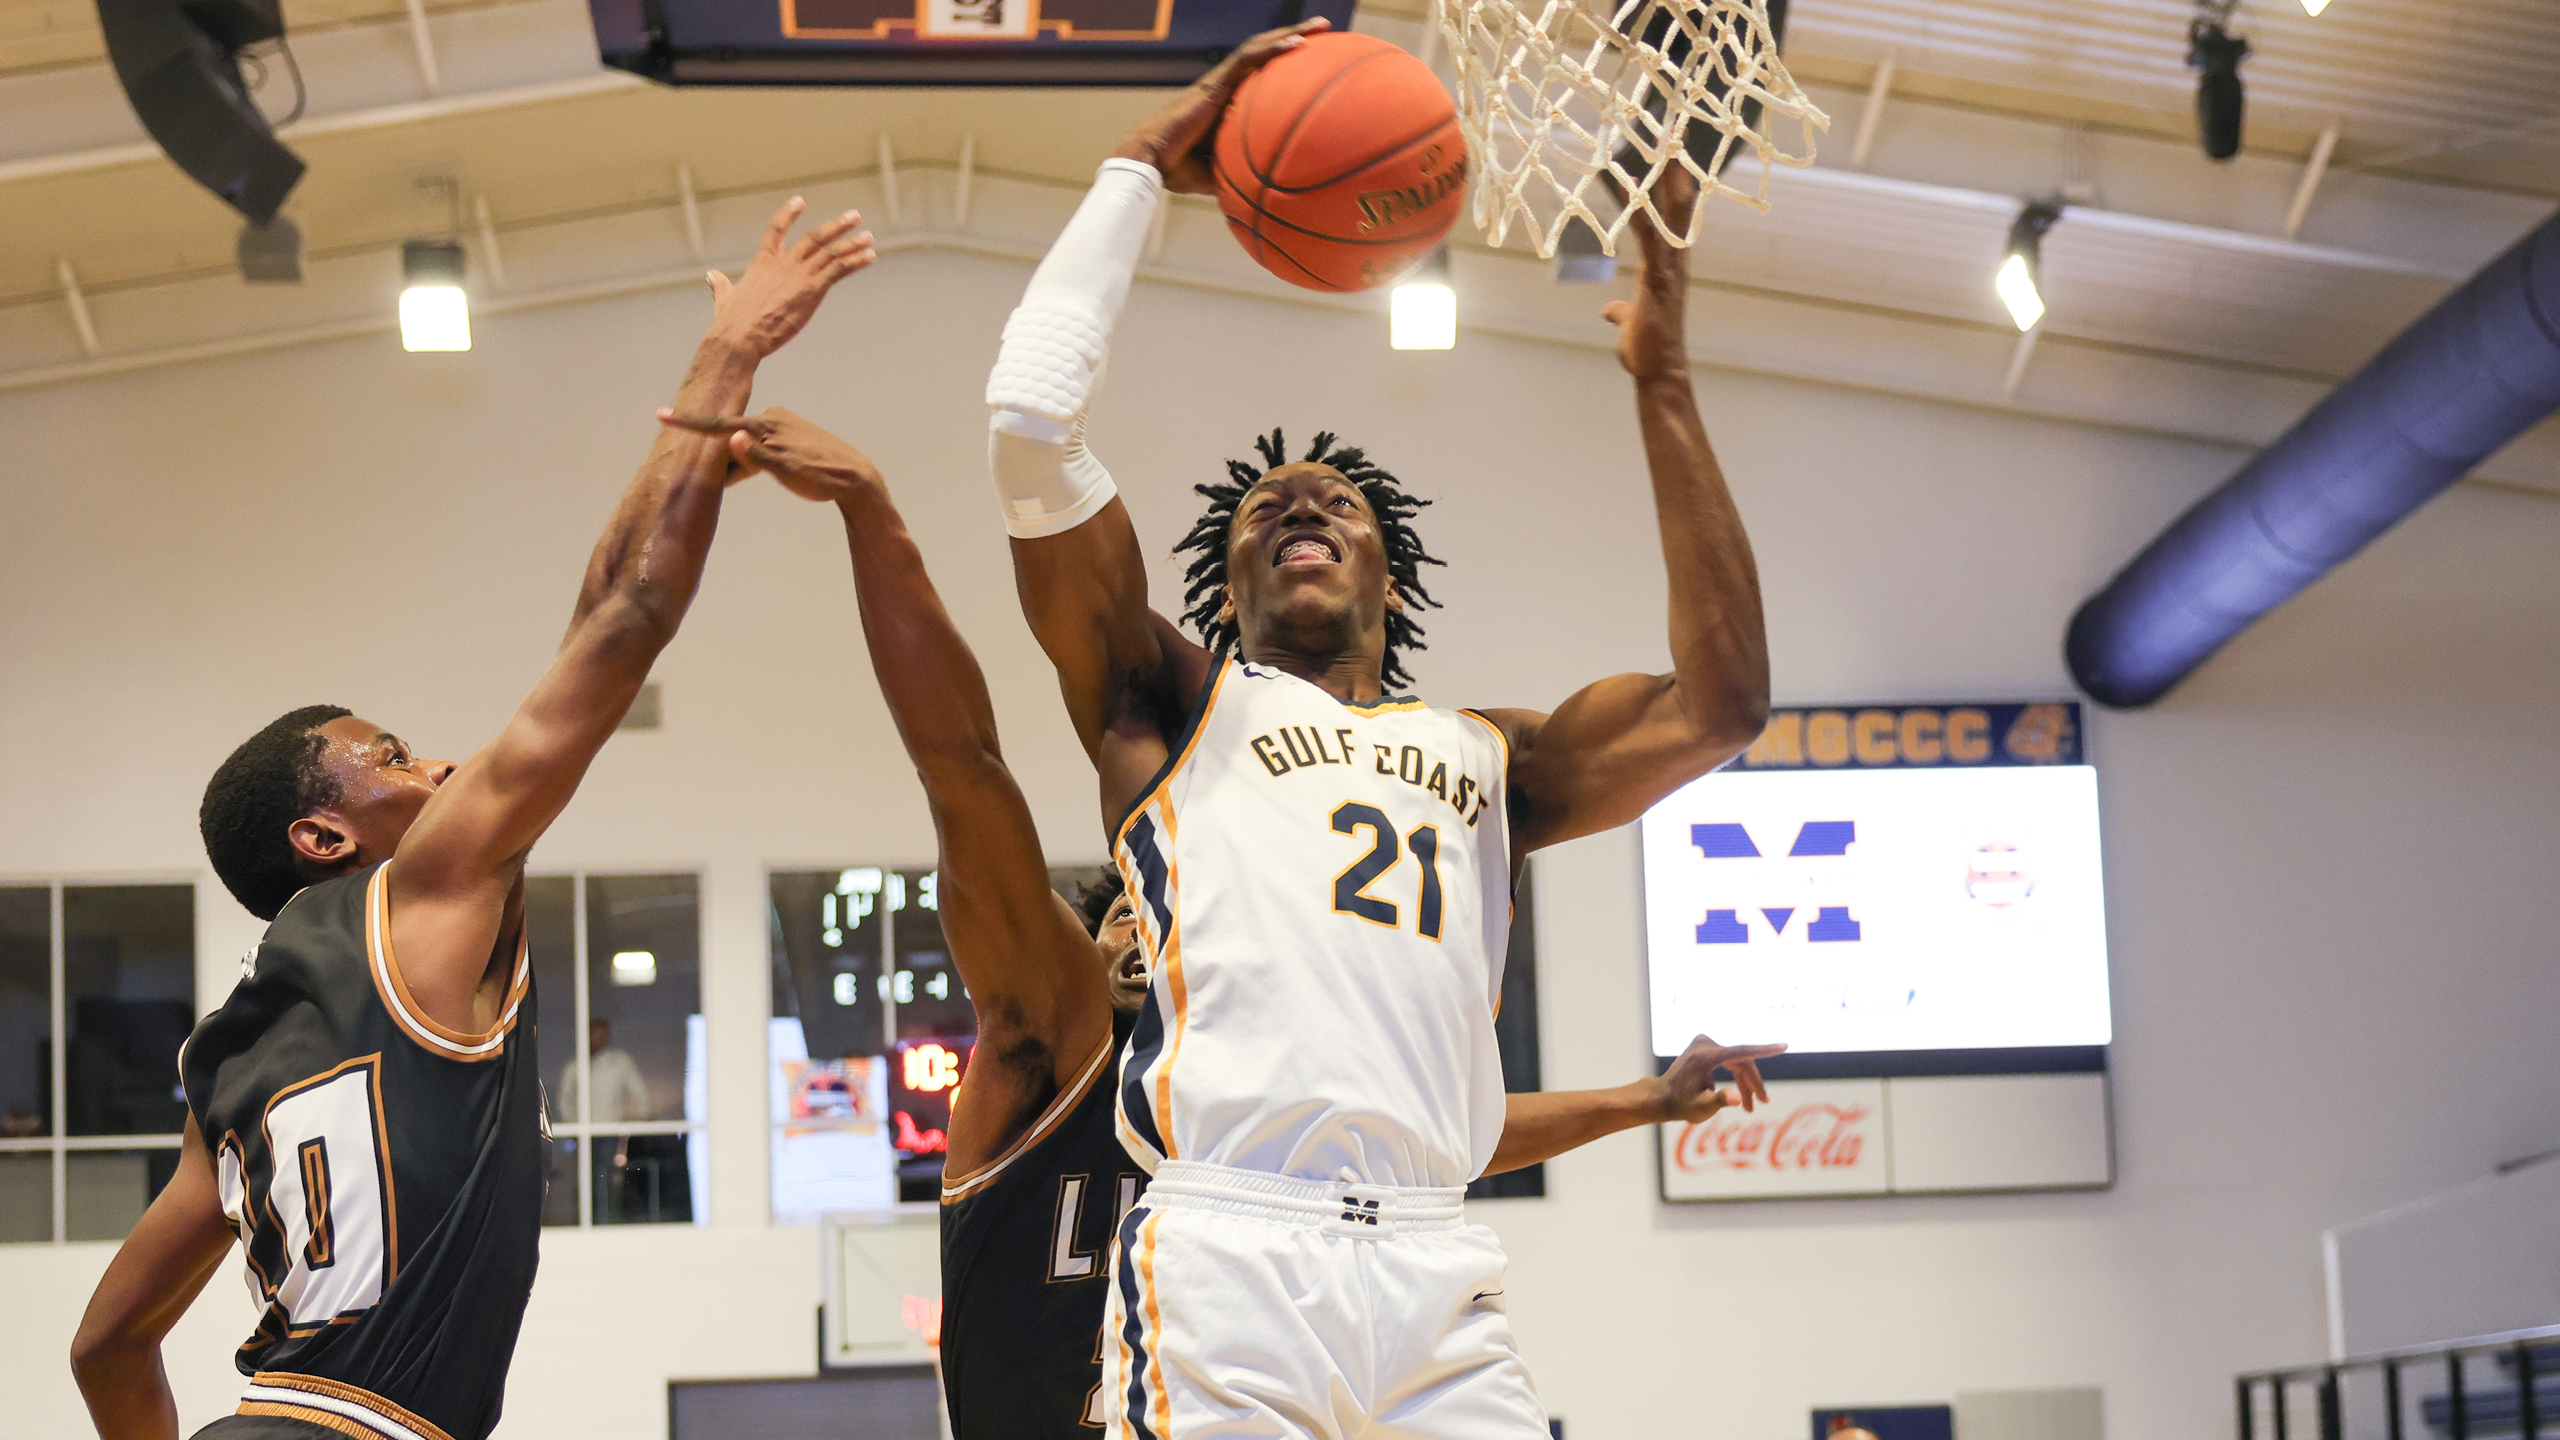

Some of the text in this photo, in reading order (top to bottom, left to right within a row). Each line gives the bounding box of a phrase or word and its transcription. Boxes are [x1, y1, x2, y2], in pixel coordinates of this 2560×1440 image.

[1251, 726, 1489, 828] GULF COAST
[1744, 711, 1990, 766] MGCCC
[1328, 799, 1446, 943] 21
